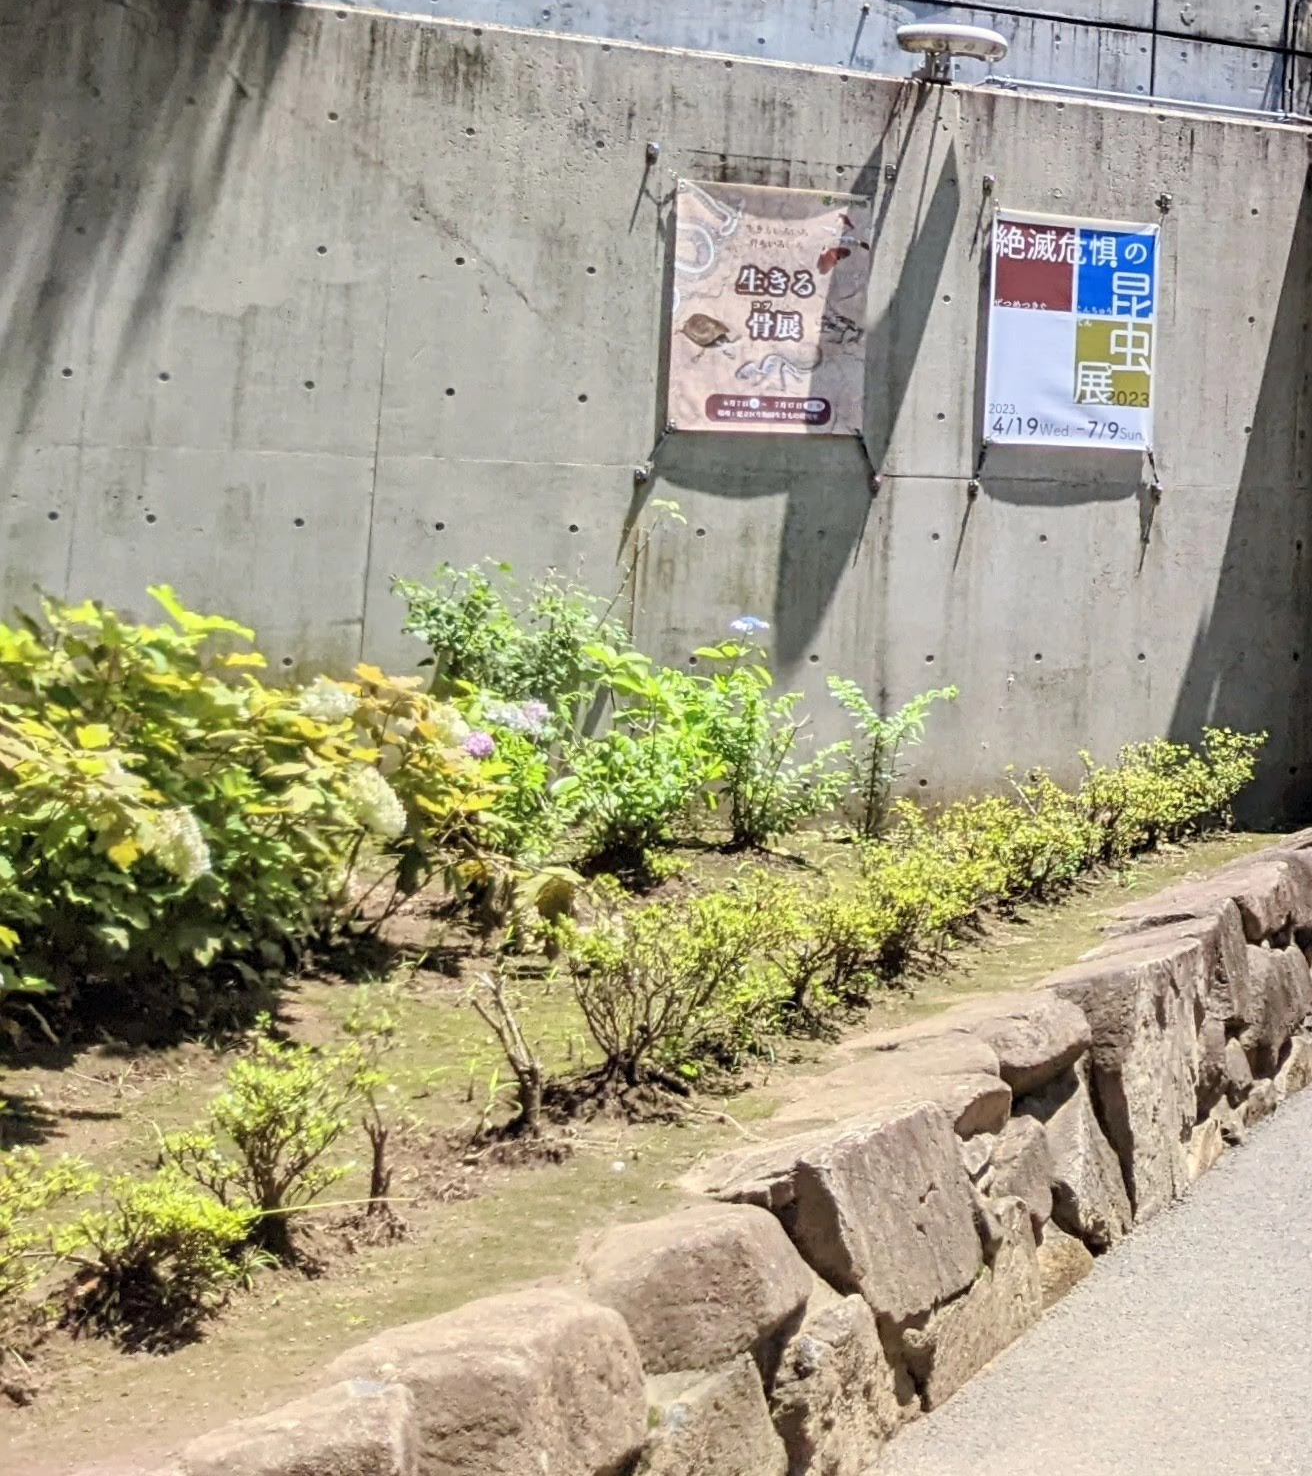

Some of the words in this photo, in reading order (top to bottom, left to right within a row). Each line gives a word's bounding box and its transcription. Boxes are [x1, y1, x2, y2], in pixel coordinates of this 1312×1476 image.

[995, 225, 1148, 267] 絶滅危惧の
[735, 265, 816, 298] 生きる
[746, 310, 804, 342] 骨展
[1106, 390, 1150, 408] 2023
